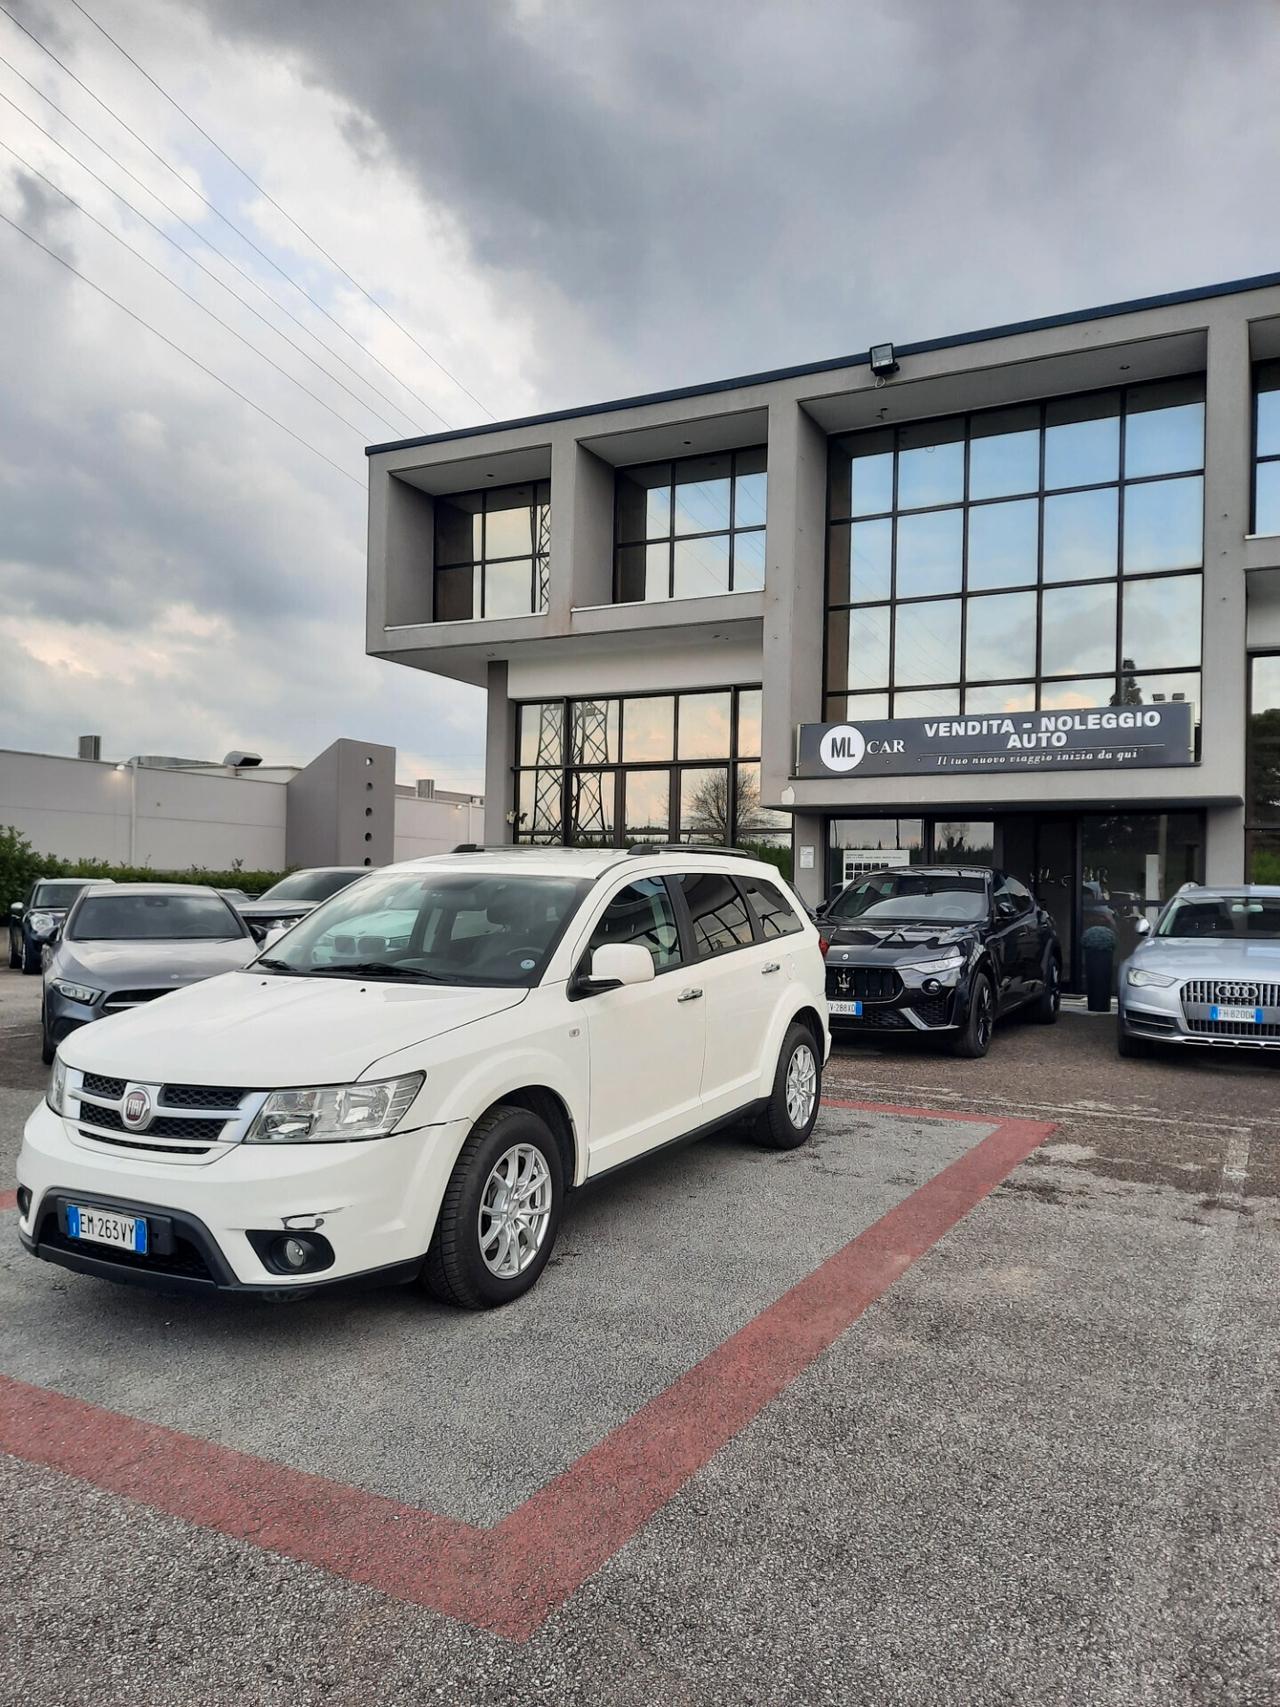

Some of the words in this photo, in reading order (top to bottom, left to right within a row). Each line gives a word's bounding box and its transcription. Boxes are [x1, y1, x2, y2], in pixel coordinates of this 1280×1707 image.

[924, 719, 1015, 737] VENDITA
[1041, 710, 1162, 732] NOLEGGIO
[830, 736, 856, 758] ML
[866, 739, 906, 755] CAR
[1007, 731, 1068, 749] AUTO
[937, 755, 948, 766] Il
[950, 756, 968, 765] tuo
[972, 755, 1006, 765] nuovo
[1009, 751, 1053, 765] viaggio
[1056, 751, 1094, 761] inizia
[1097, 749, 1113, 760] da
[1116, 748, 1138, 762] qui
[127, 1099, 145, 1116] FIAT
[80, 1213, 95, 1235] EM
[98, 1218, 134, 1244] 263VY
